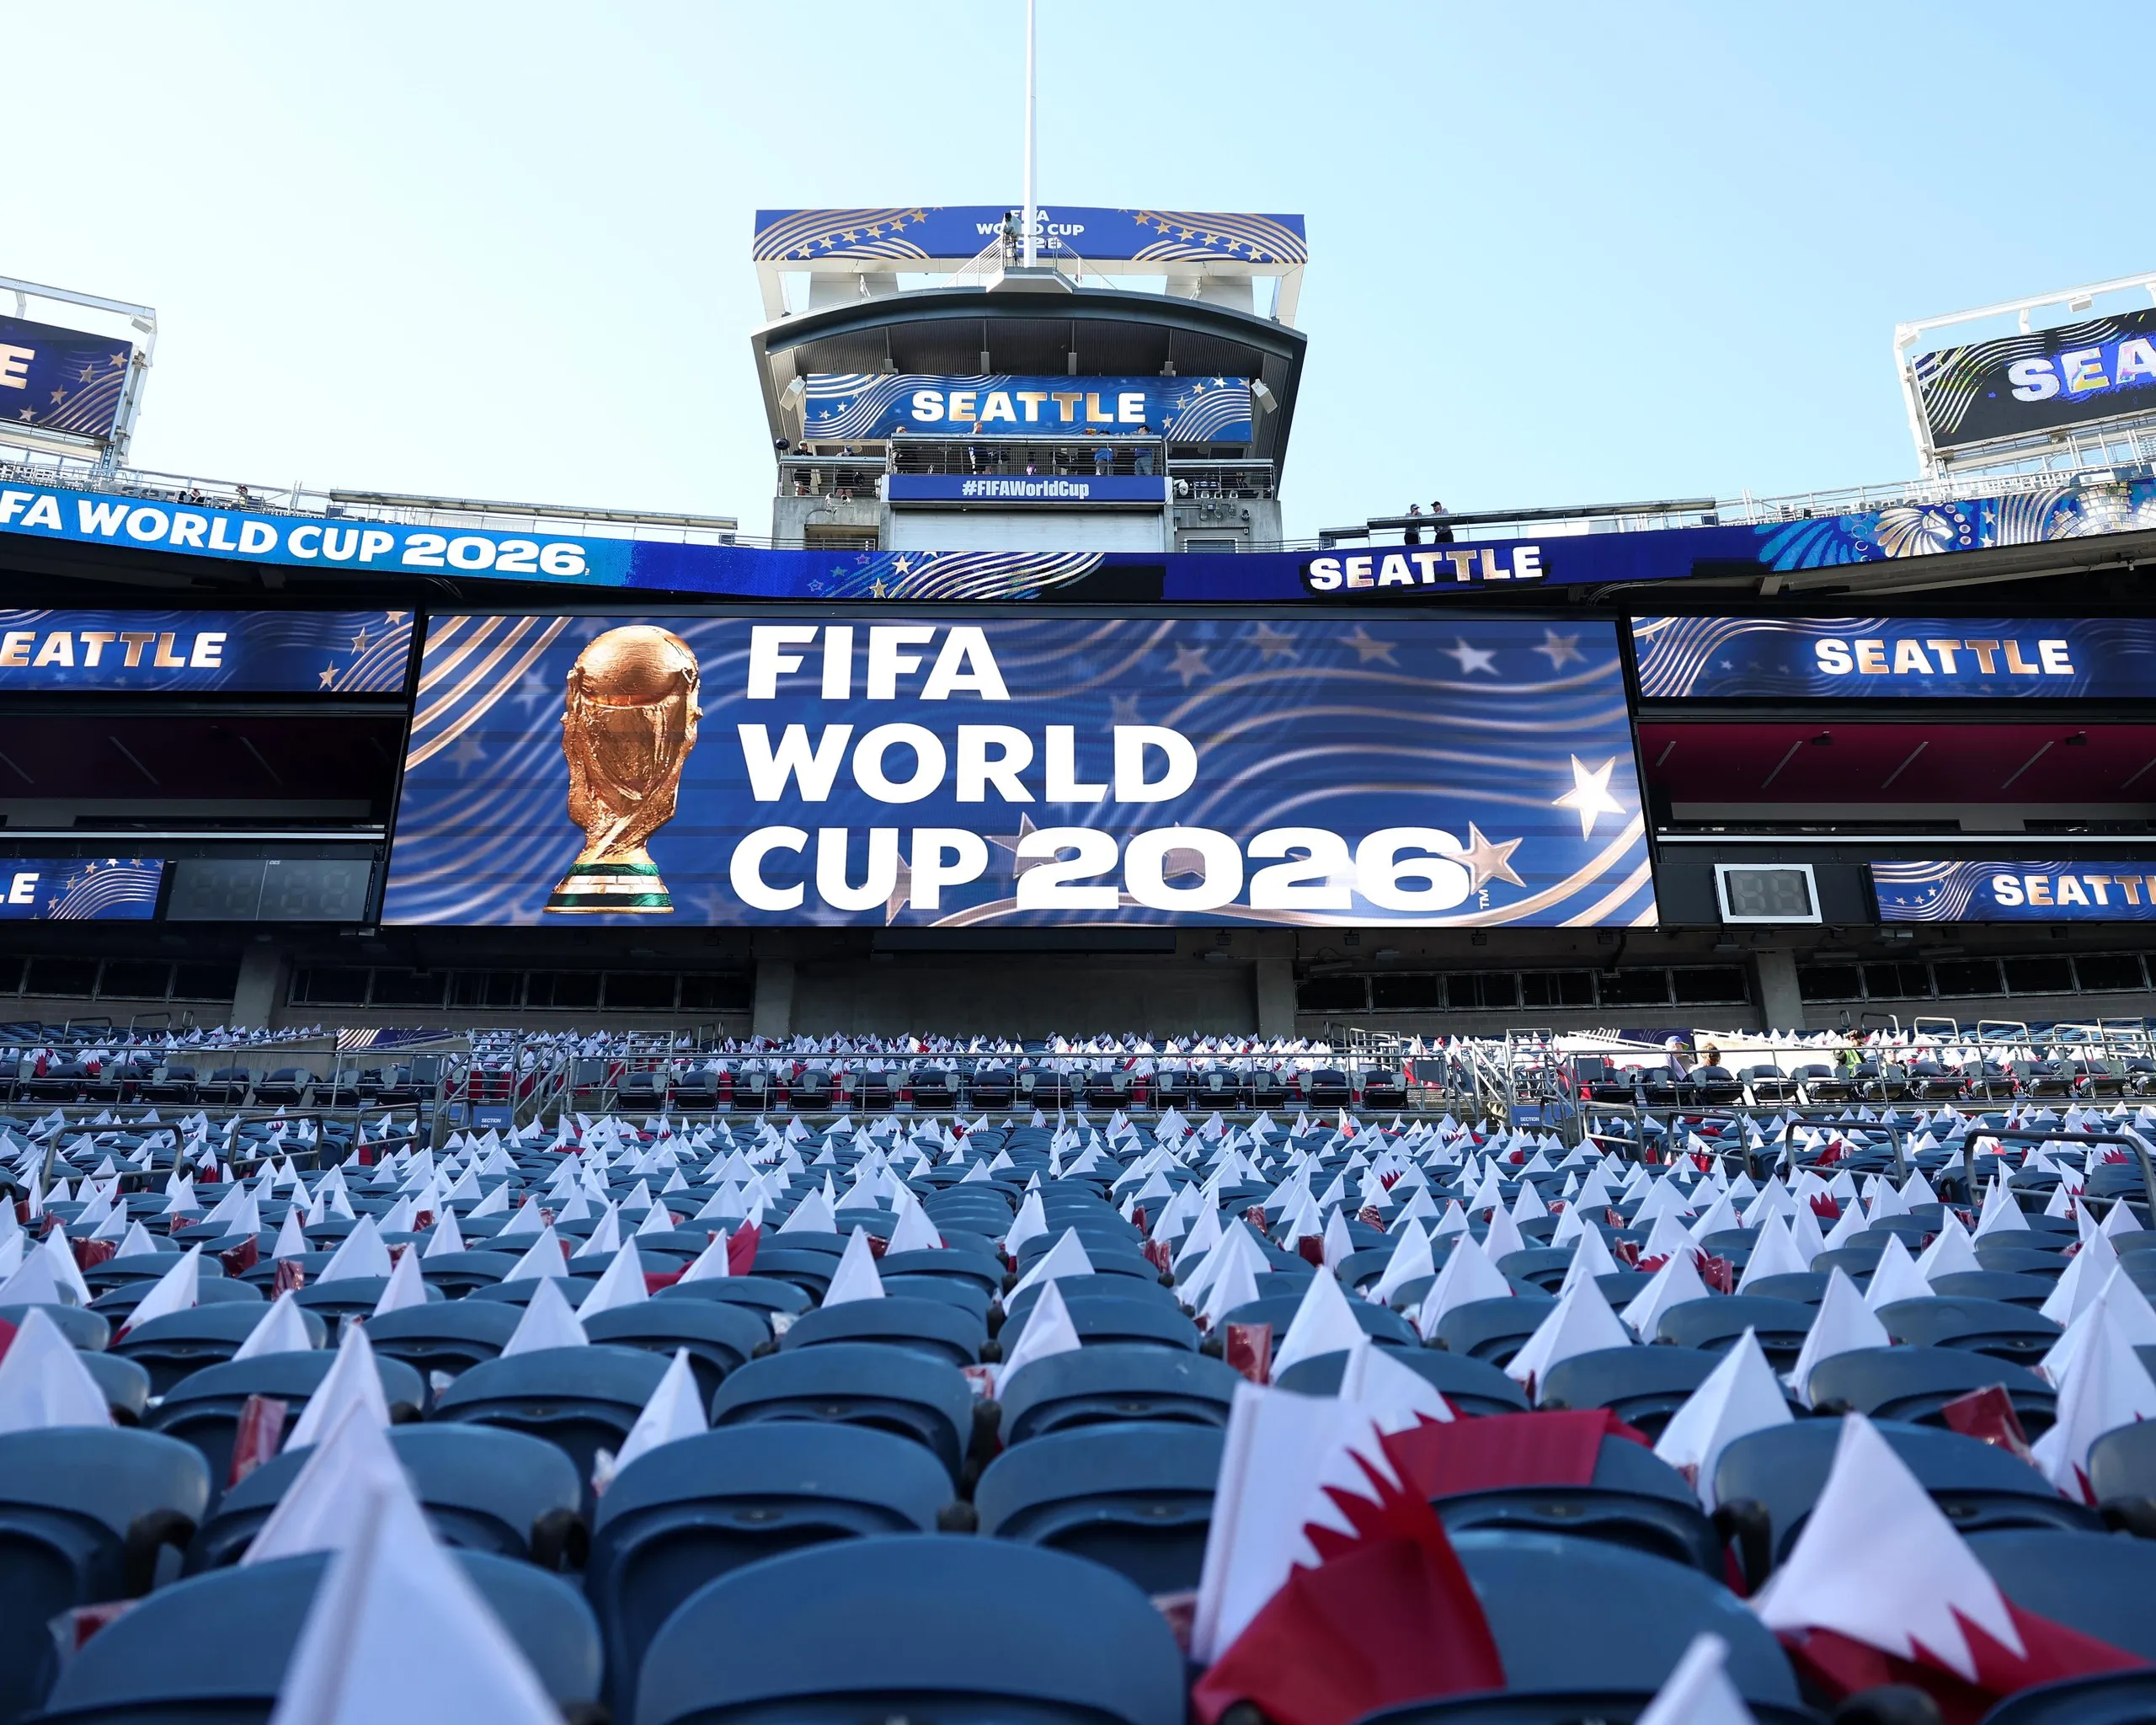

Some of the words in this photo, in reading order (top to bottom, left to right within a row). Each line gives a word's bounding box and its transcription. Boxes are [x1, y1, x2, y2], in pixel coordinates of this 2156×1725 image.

[1048, 224, 1085, 235] CUP
[2008, 338, 2156, 402] SEA
[911, 391, 1146, 423] SEATTLE
[962, 480, 1090, 499] #FIFAWorldCup
[77, 499, 278, 553] WORLD
[287, 525, 395, 563] CUP
[402, 536, 585, 576] 2026
[1309, 546, 1543, 590] SEATTLE
[0, 631, 228, 667] EATTLE
[747, 625, 1011, 700] FIFA
[1815, 638, 2074, 675] SEATTLE
[737, 723, 1198, 804] WORLD
[729, 825, 989, 911] CUP
[1016, 826, 1470, 911] 2026
[0, 873, 40, 904] E
